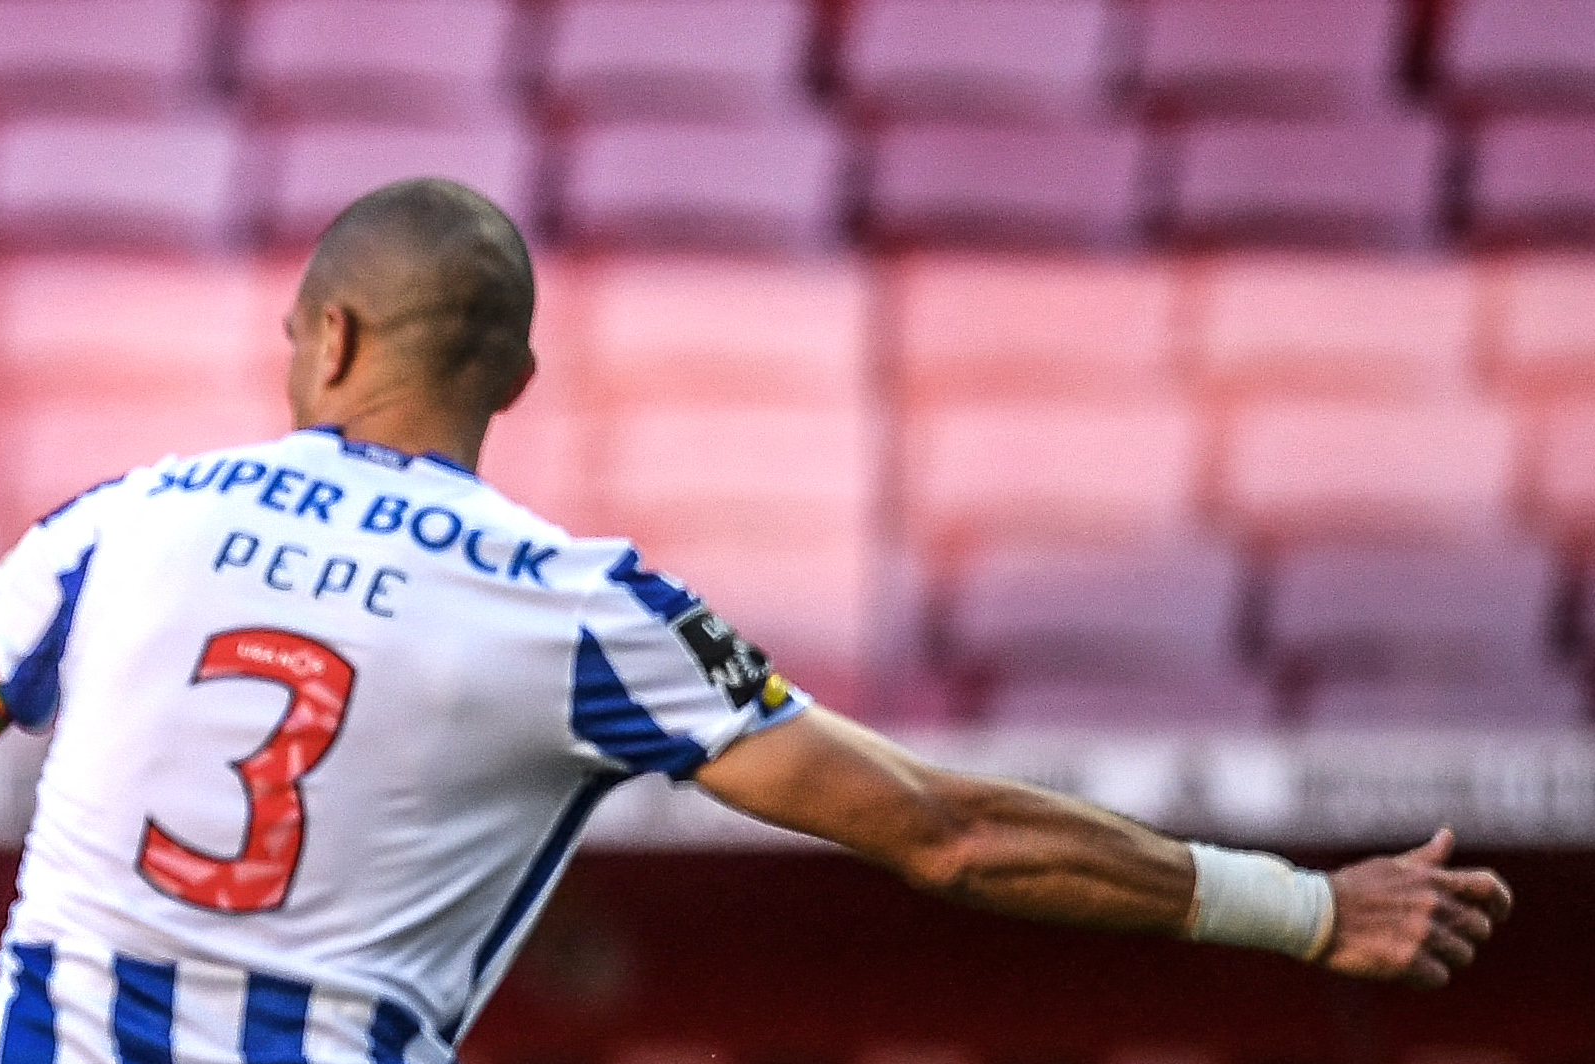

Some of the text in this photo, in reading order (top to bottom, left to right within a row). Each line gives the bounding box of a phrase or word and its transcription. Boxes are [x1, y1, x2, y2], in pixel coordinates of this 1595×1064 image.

[212, 532, 408, 618] PEPE
[359, 496, 559, 587] BOCK
[136, 626, 356, 915] 3
